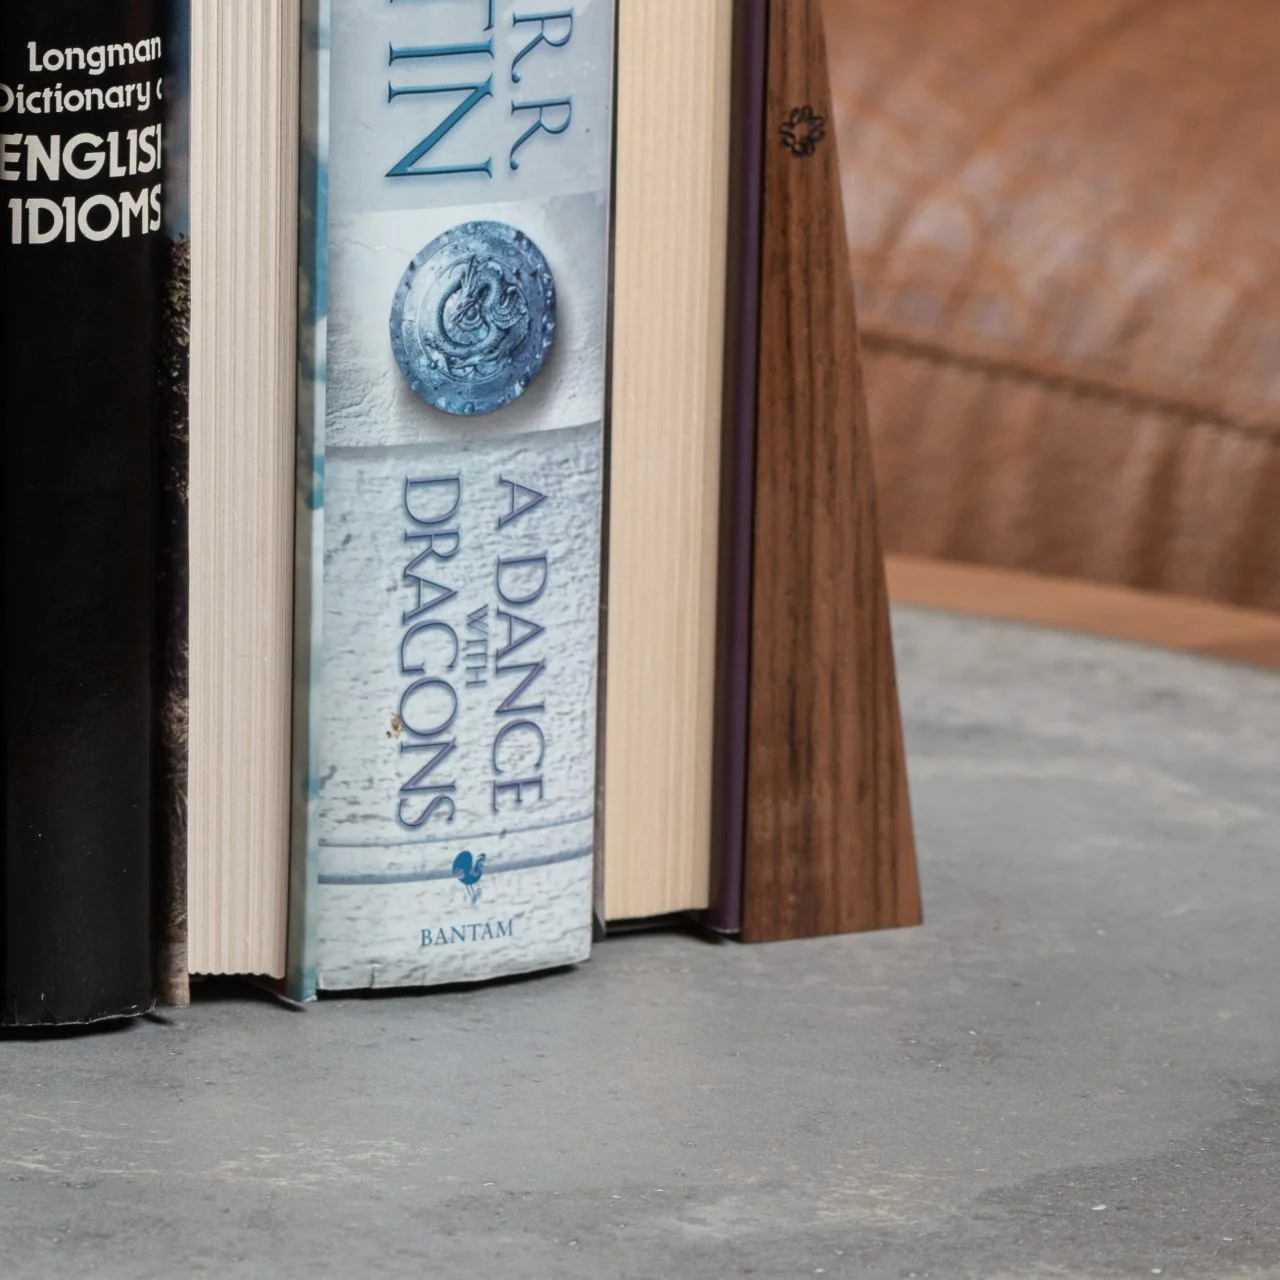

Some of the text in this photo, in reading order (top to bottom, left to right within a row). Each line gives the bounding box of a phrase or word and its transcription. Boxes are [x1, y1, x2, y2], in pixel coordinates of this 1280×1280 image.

[27, 37, 161, 75] Longman
[8, 184, 161, 244] IDIOMS
[398, 472, 461, 831] DRAGONS
[465, 604, 488, 687] WITH
[492, 473, 548, 815] A DANCE
[421, 921, 513, 947] BANTAM
